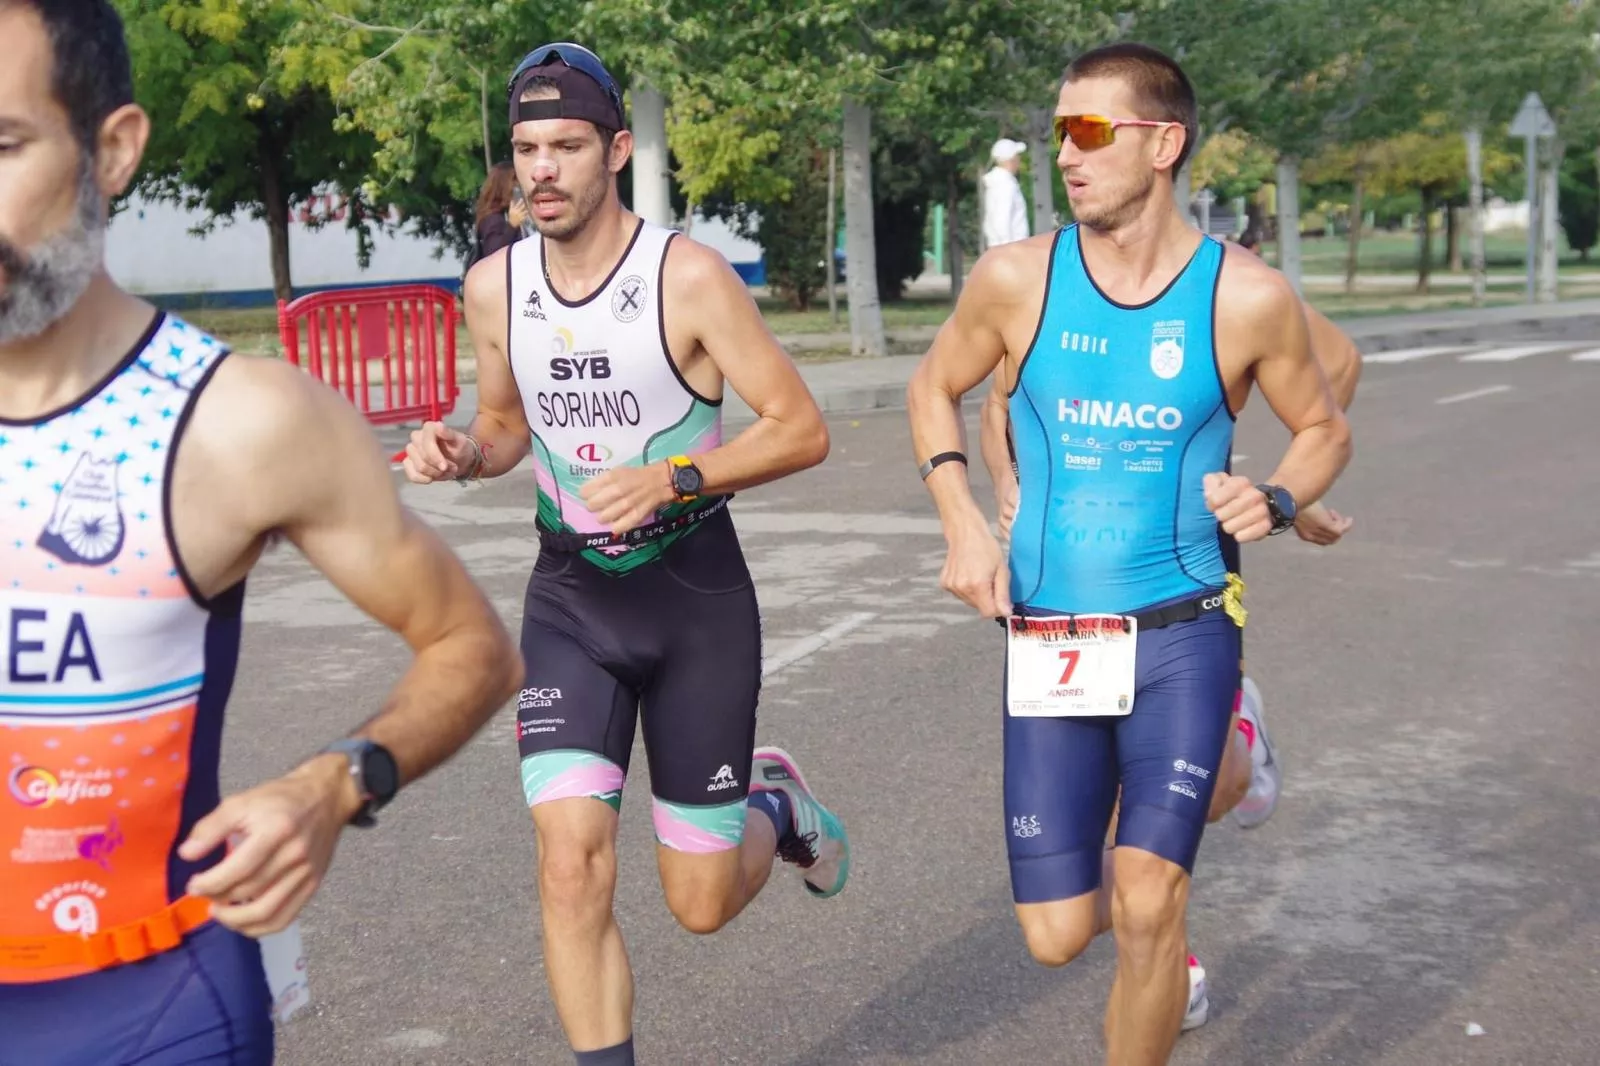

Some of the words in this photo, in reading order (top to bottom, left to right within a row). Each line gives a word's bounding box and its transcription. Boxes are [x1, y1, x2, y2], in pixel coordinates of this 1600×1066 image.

[1061, 331, 1108, 354] GOBIK
[550, 357, 611, 380] SYB
[538, 391, 640, 428] SORIANO
[1058, 650, 1080, 685] 7
[707, 781, 738, 792] austral
